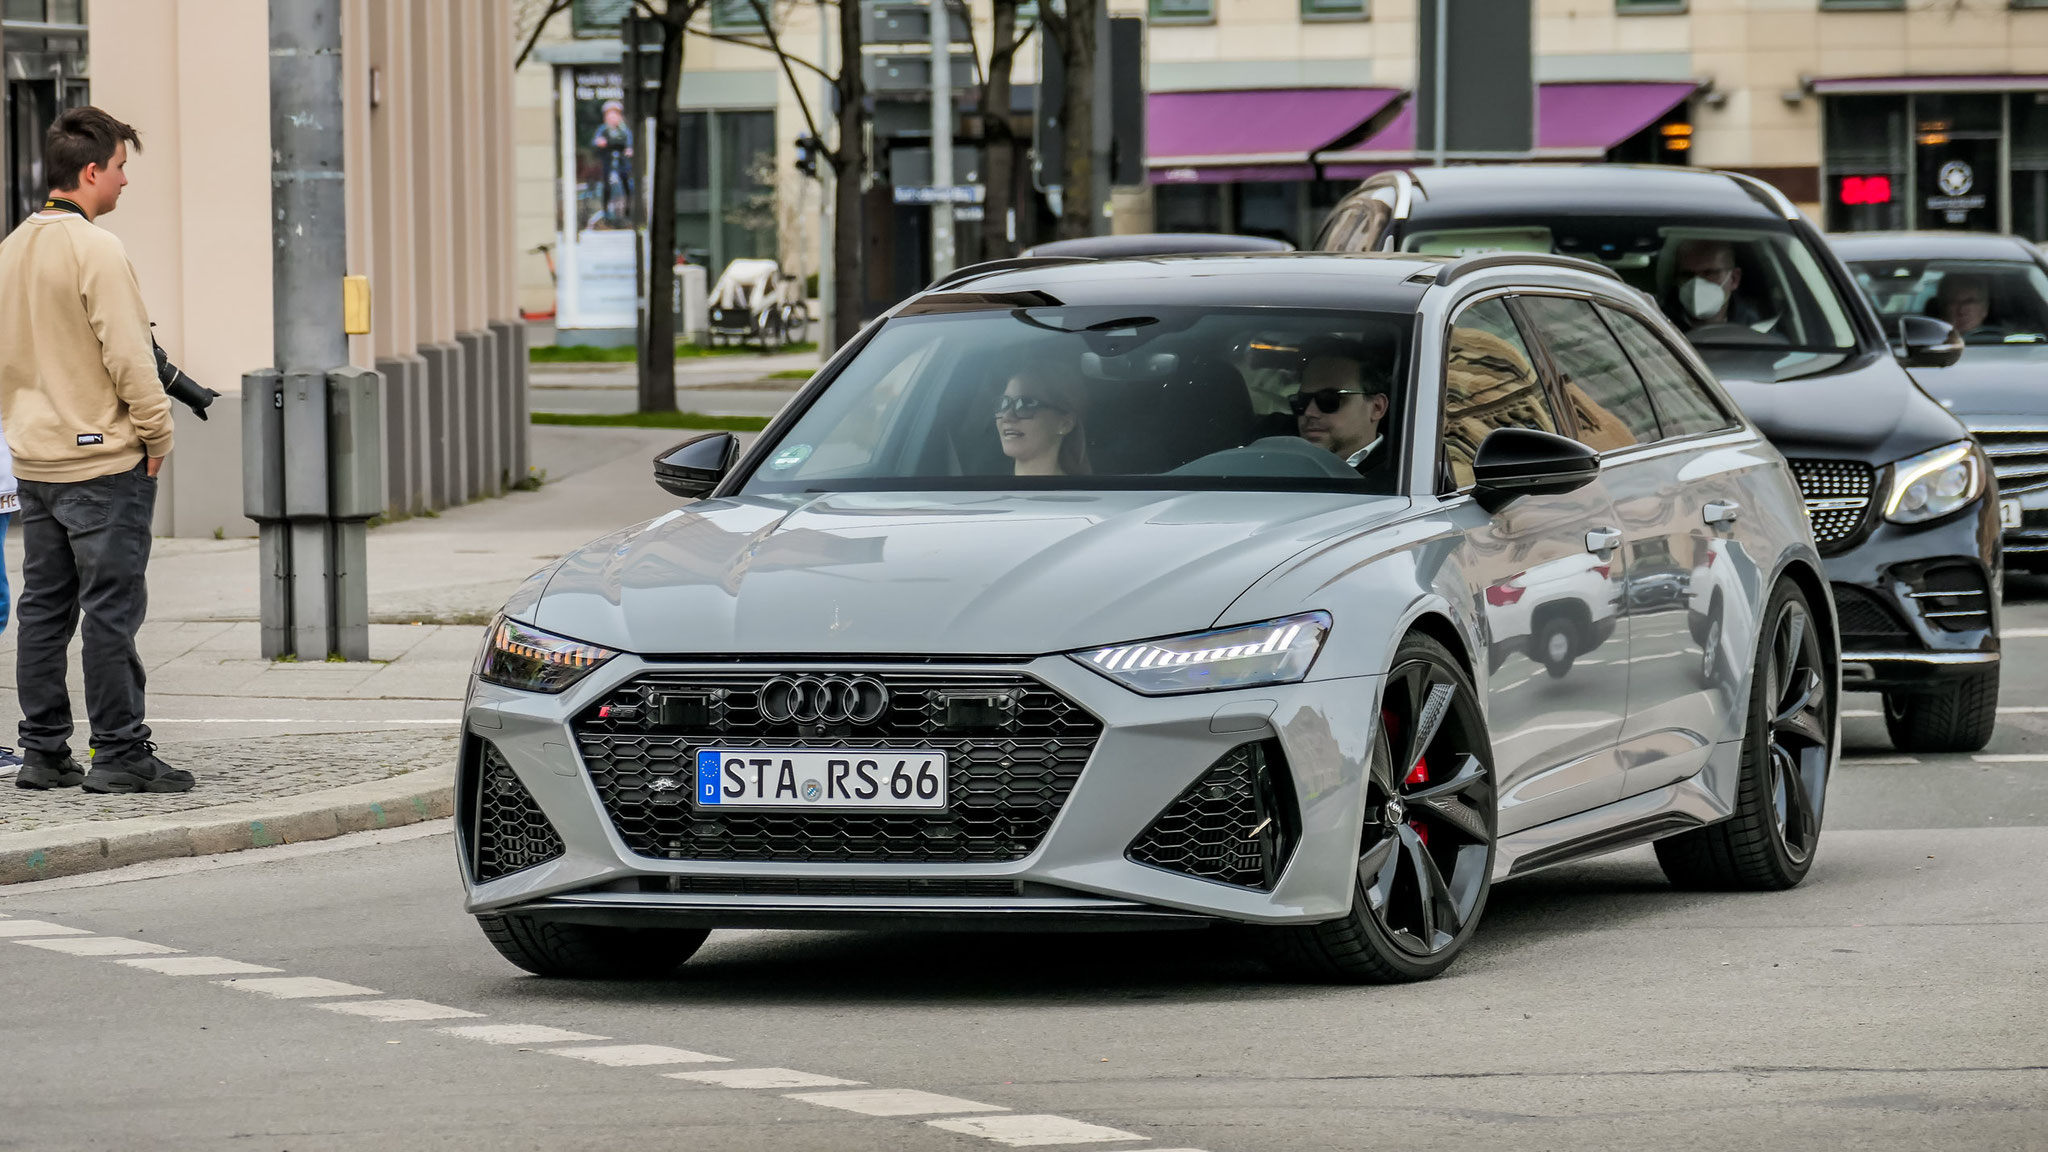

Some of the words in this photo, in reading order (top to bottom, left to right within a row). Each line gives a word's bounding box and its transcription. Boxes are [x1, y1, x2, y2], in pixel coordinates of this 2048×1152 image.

[275, 392, 282, 408] 3
[723, 758, 798, 799] STA
[828, 759, 878, 800] RS
[890, 760, 938, 800] 66
[705, 784, 714, 796] D
